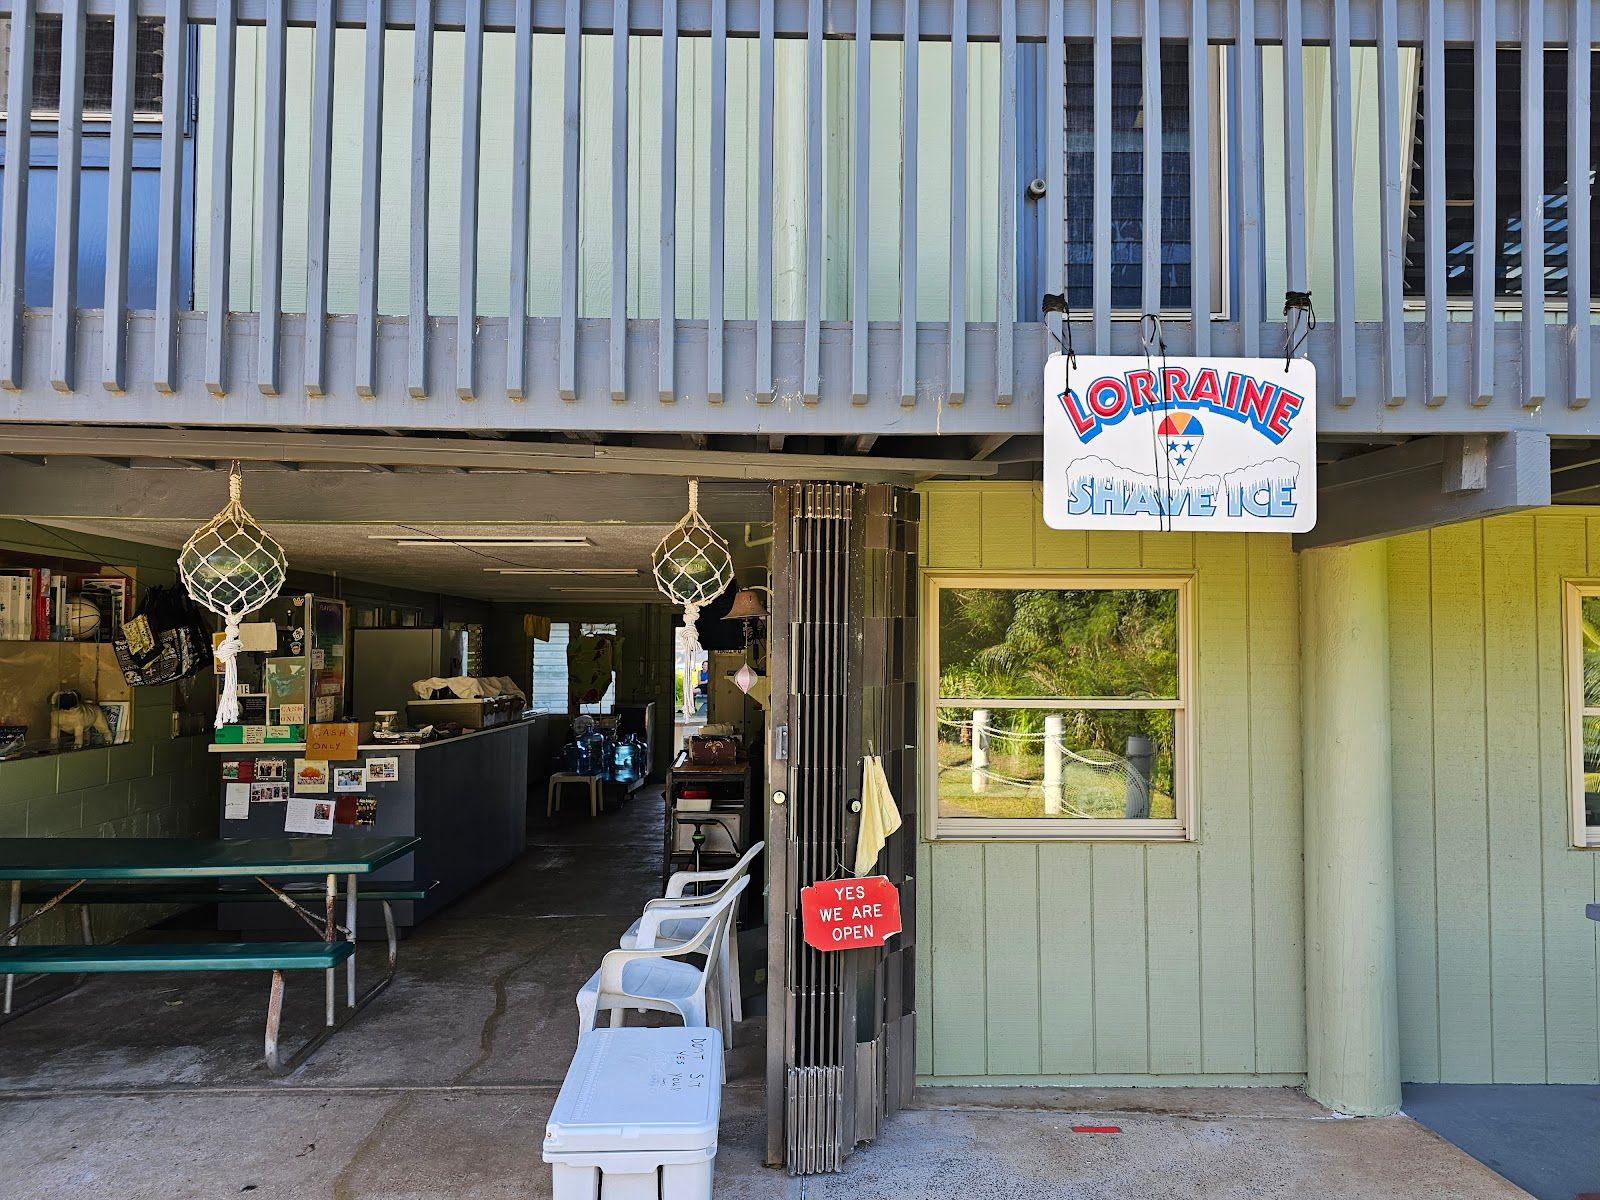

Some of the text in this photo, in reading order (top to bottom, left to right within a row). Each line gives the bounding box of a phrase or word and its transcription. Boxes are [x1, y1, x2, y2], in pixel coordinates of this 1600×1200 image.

[1057, 367, 1304, 445] LORRAINE
[1067, 477, 1298, 518] SHAVE ICE
[312, 742, 341, 751] ONLY
[834, 886, 865, 901] YES
[819, 903, 883, 922] WE ARE
[832, 924, 874, 942] OPEN
[673, 1050, 688, 1065] YES
[688, 1073, 704, 1088] SIT
